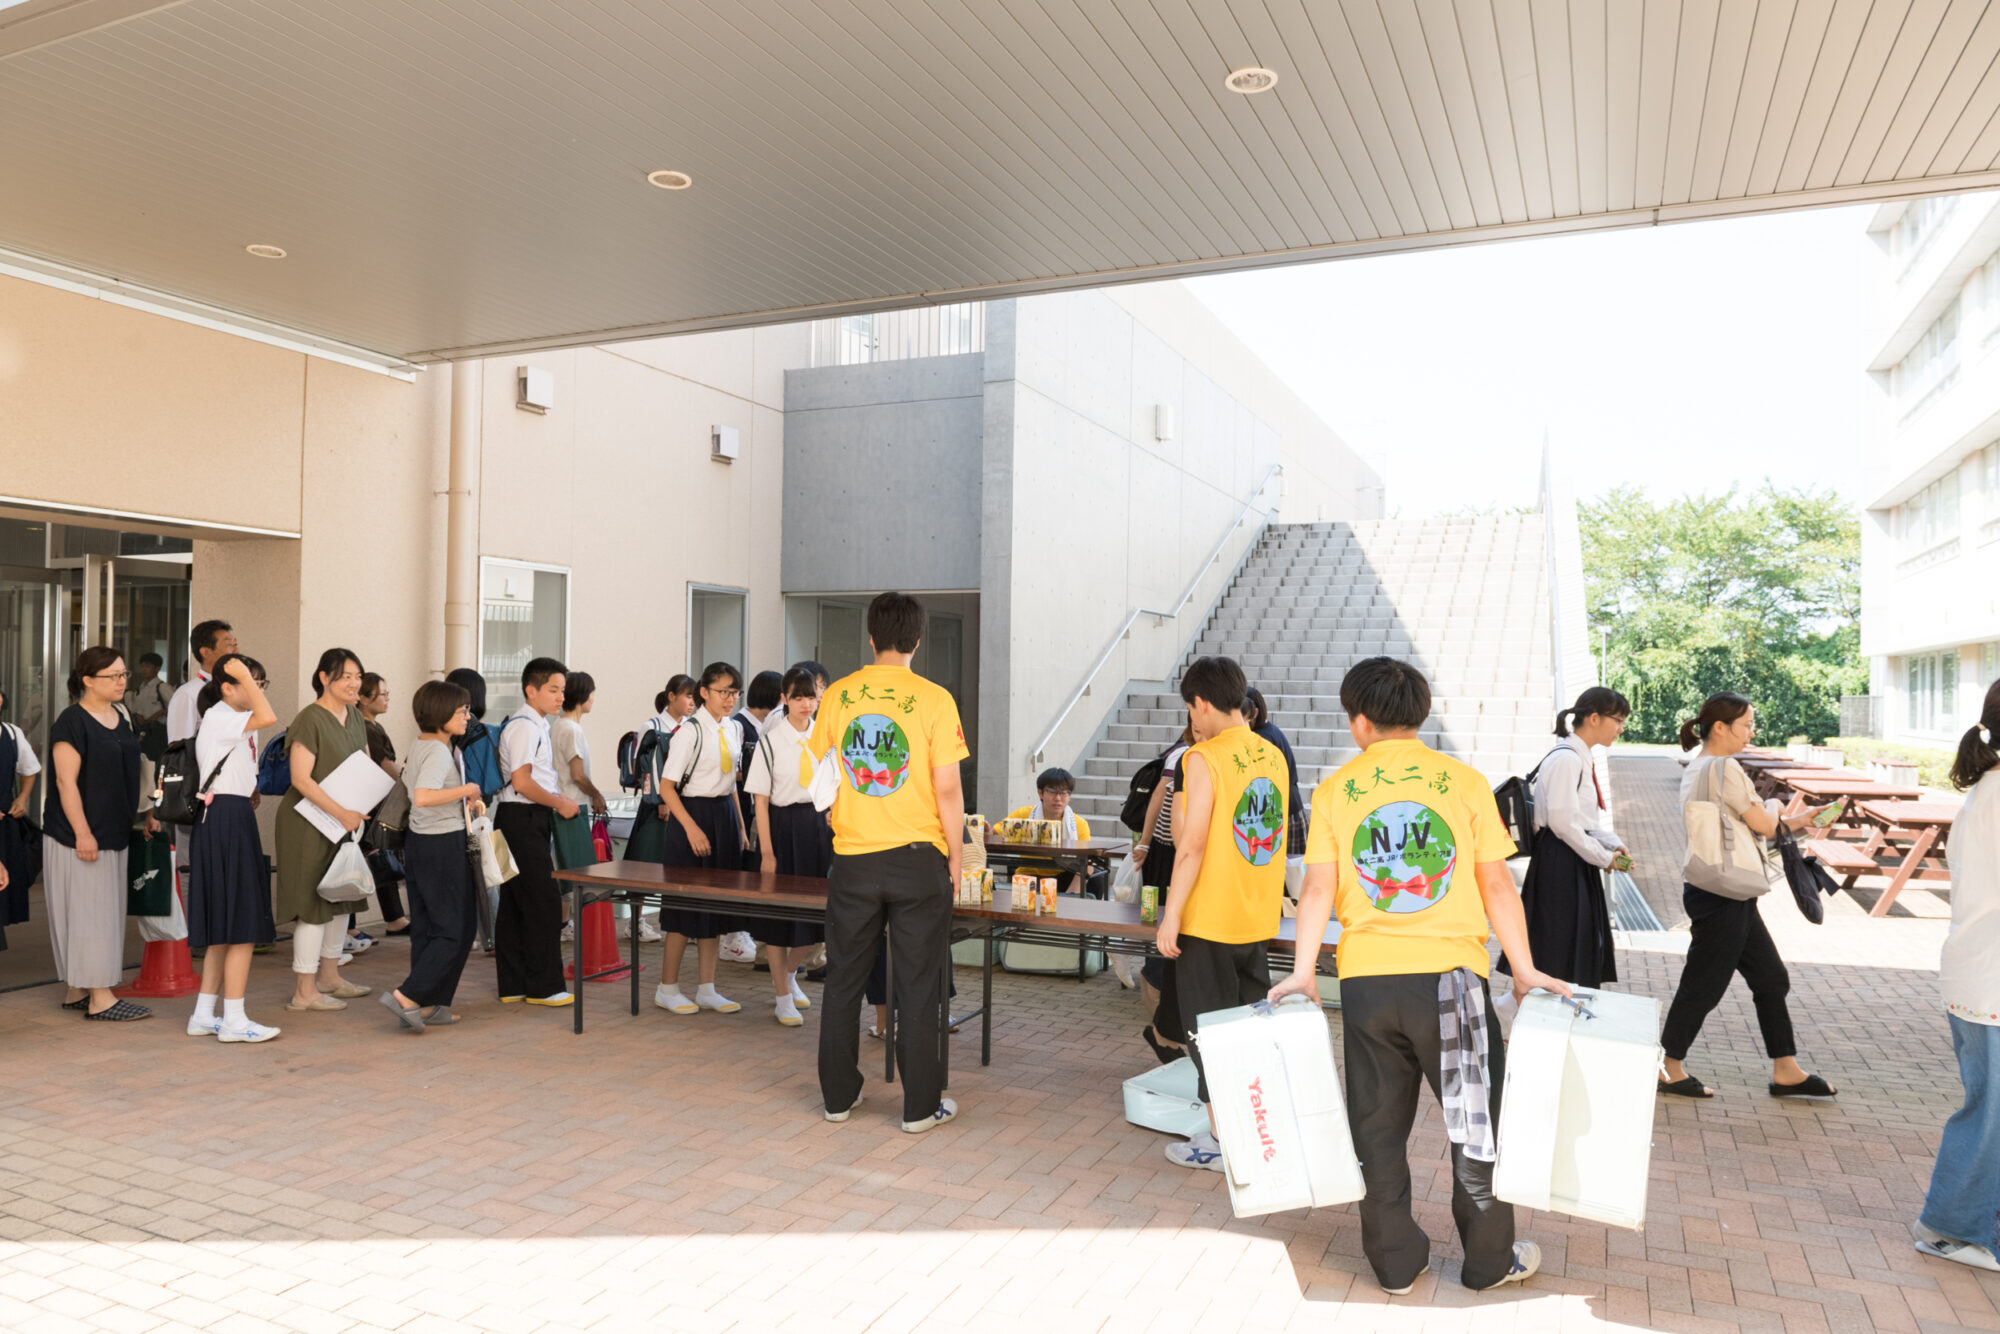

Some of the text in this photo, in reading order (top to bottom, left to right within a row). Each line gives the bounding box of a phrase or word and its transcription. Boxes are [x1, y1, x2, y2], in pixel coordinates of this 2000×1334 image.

[852, 729, 896, 752] NJV
[1370, 821, 1431, 855] NJV
[1248, 1076, 1277, 1162] Yakult
